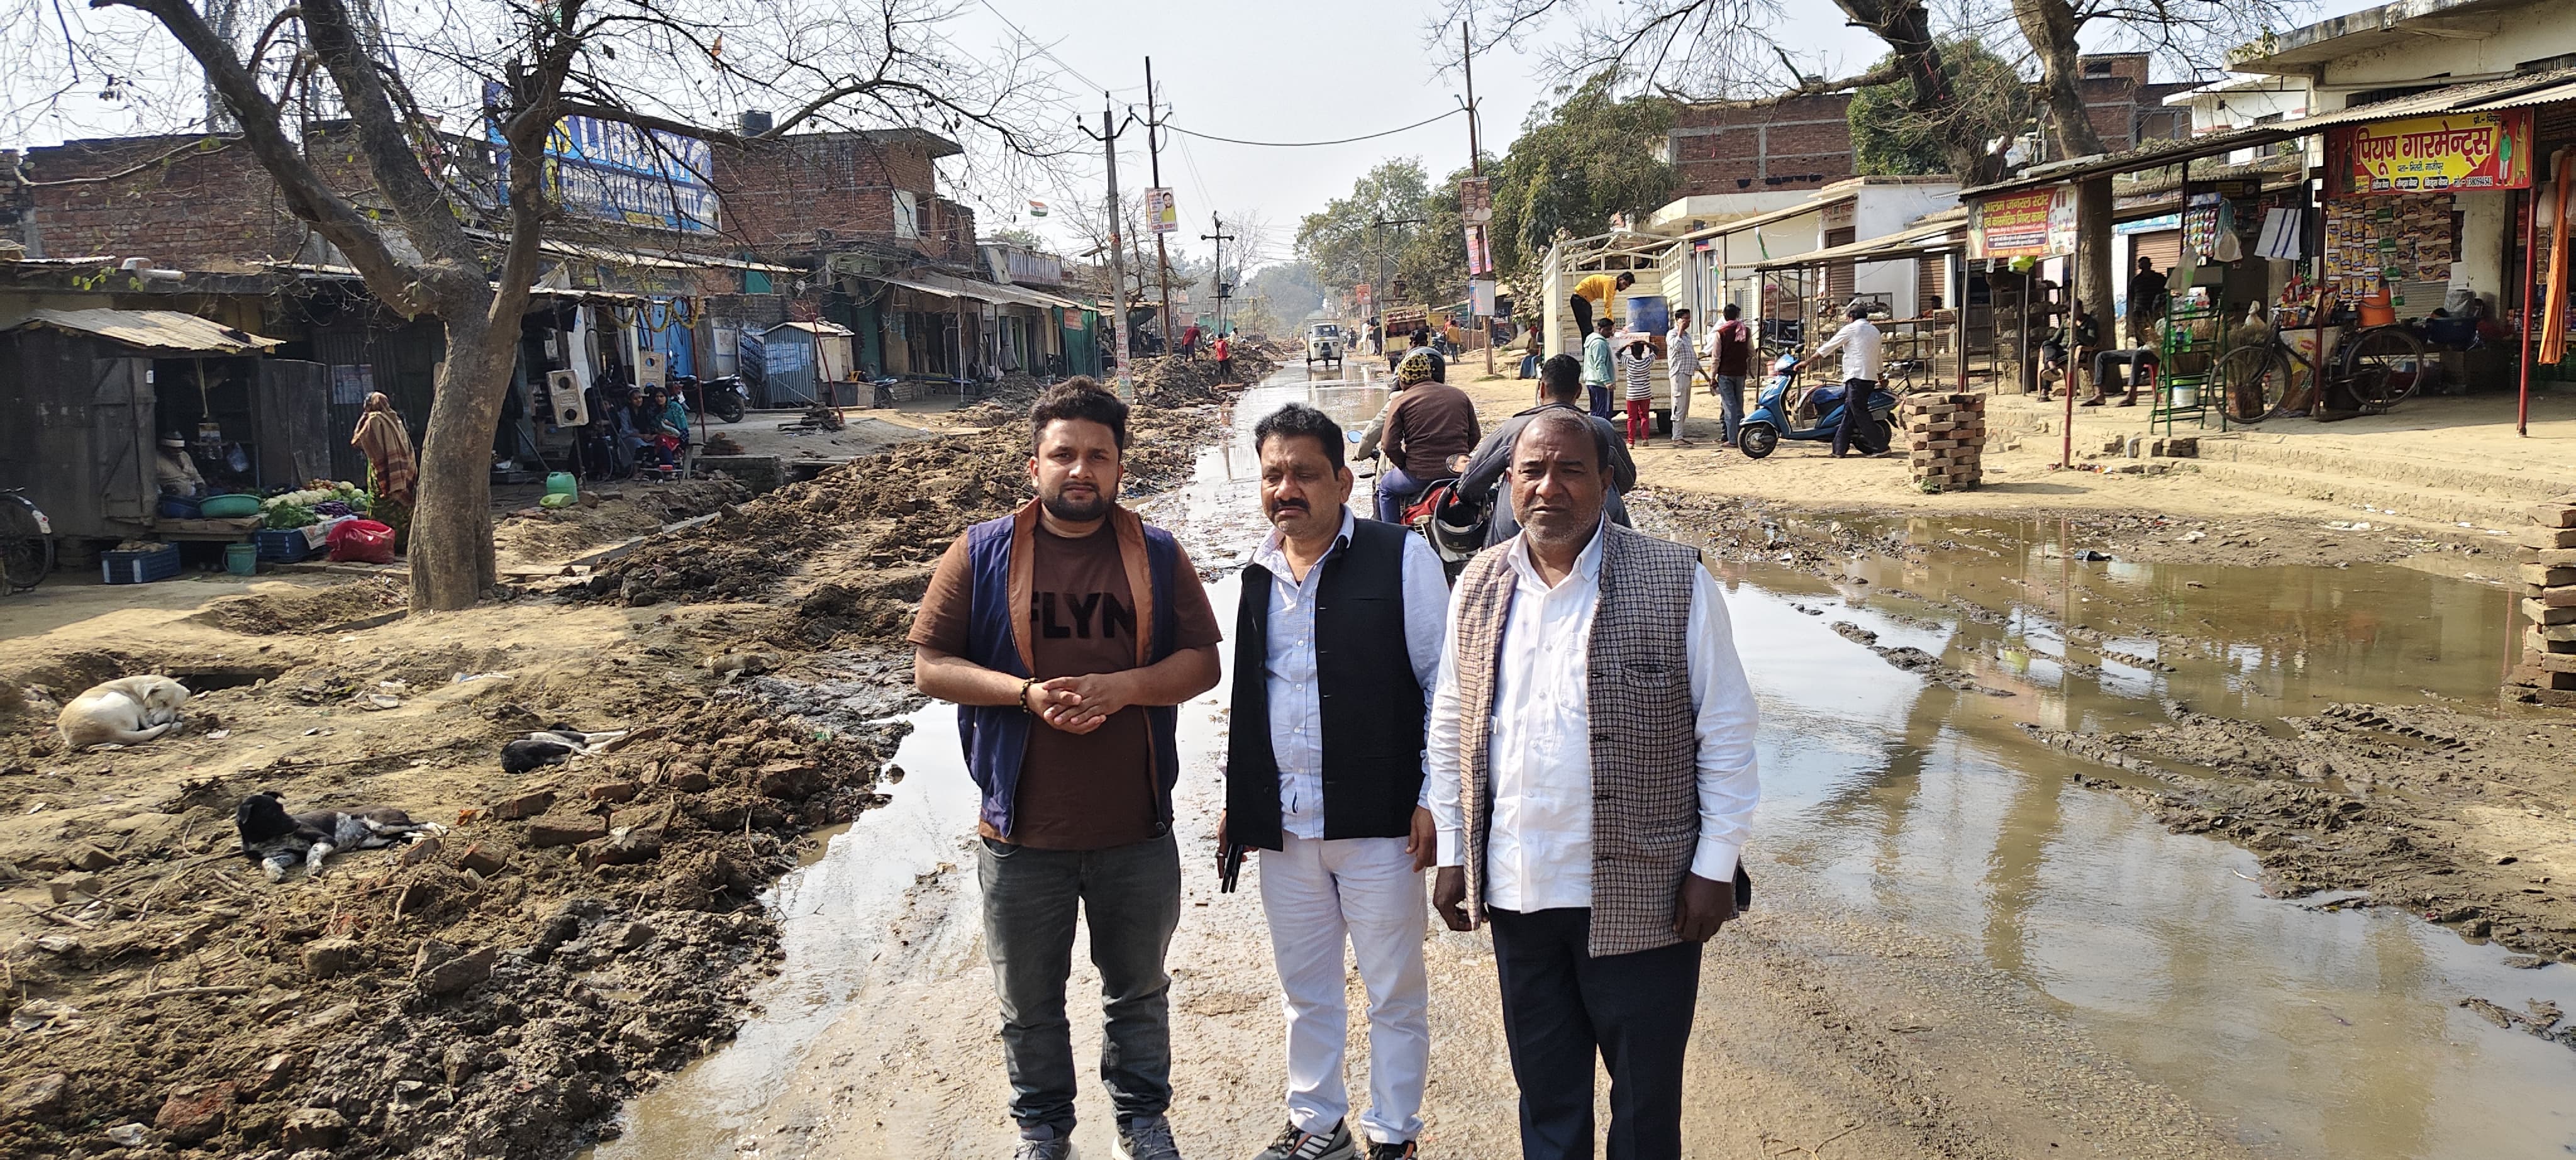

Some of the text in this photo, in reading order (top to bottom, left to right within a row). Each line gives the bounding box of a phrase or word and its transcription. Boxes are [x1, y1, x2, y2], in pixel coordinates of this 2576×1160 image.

[2357, 120, 2492, 175] पियूष गारमेन्ट्स
[1984, 192, 2050, 213] आलम जनरल स्टोर
